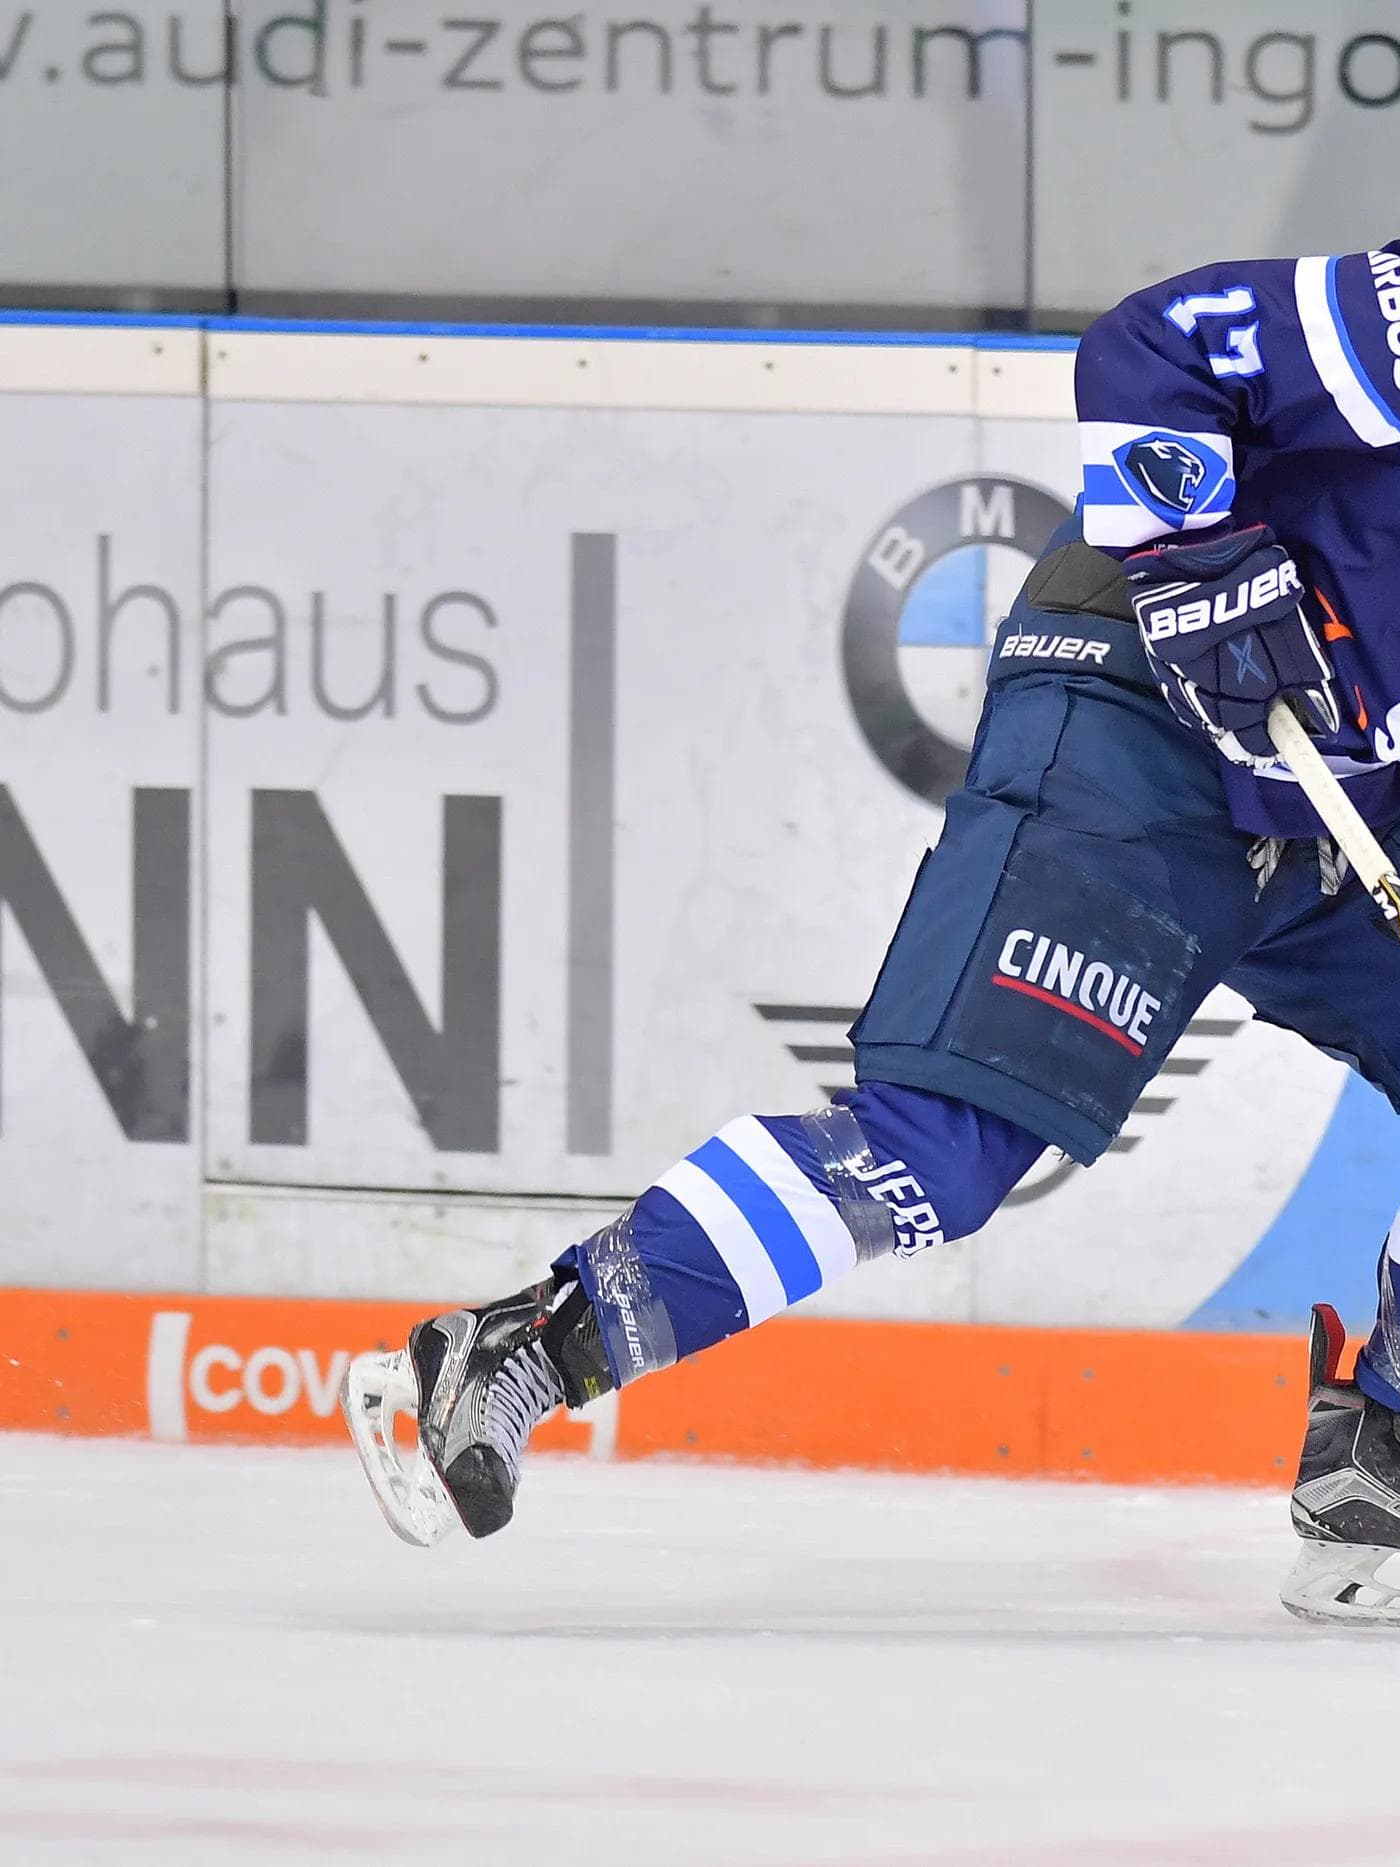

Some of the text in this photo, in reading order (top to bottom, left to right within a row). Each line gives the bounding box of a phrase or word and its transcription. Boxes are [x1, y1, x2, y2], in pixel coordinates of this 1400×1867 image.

[1162, 285, 1265, 379] 17
[1148, 559, 1302, 642] BAUER
[999, 633, 1112, 666] BAUER
[997, 928, 1162, 1046] CINQUE
[615, 1293, 645, 1370] BAUER
